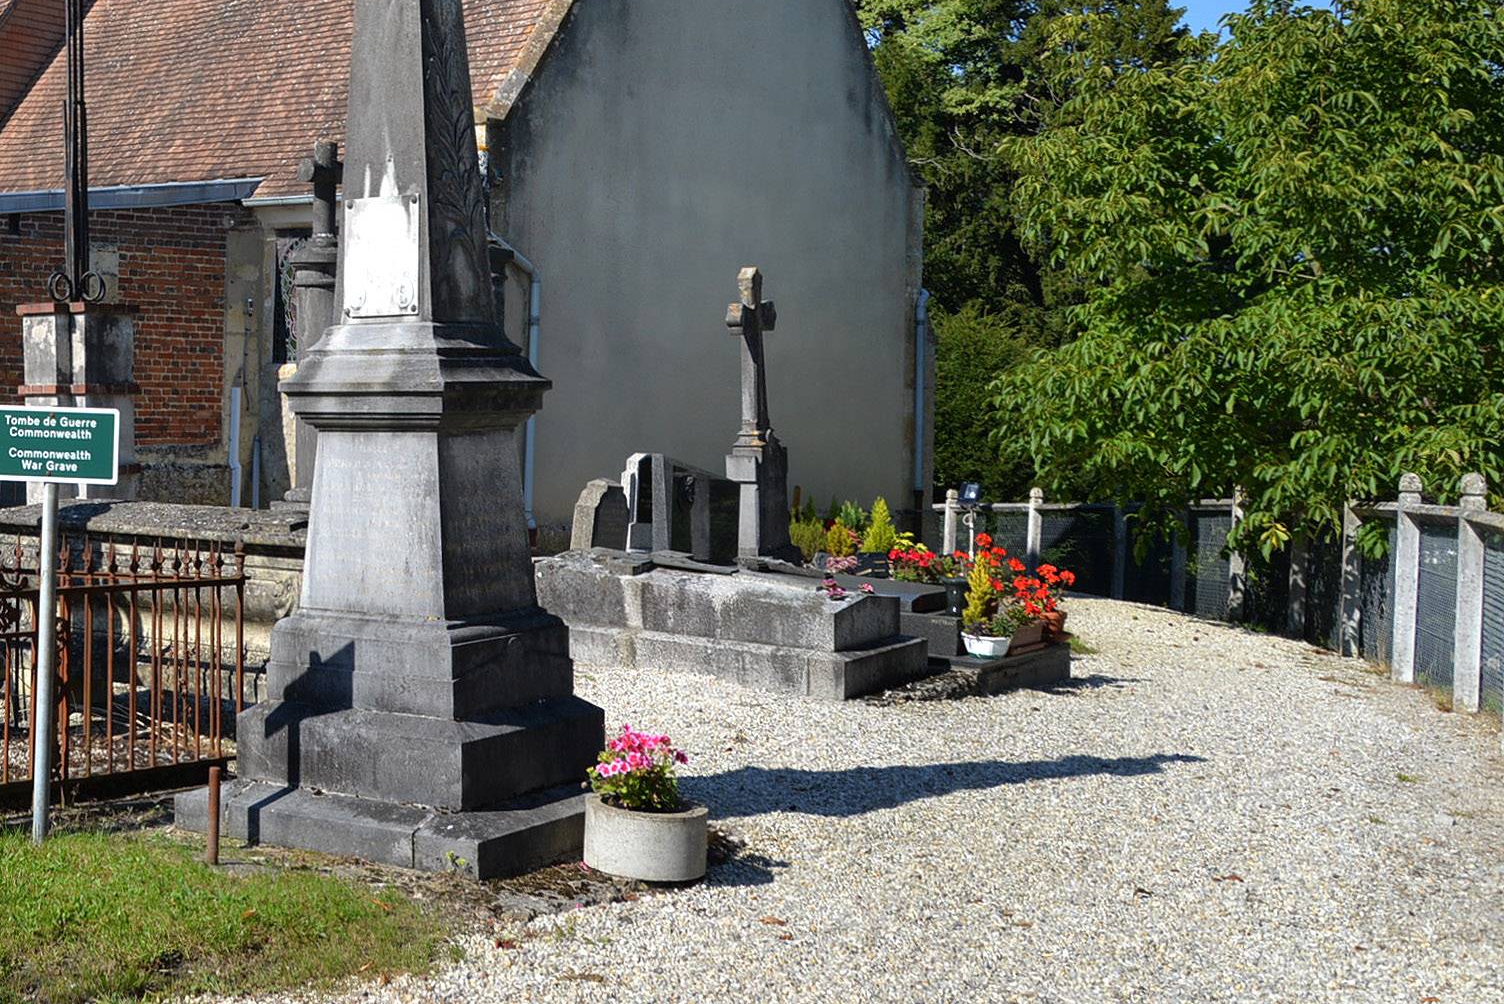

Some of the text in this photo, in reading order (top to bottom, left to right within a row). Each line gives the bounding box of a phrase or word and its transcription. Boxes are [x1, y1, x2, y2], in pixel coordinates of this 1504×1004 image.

[4, 414, 97, 428] Tombe de Guerre
[9, 426, 92, 440] Commonwealth
[8, 447, 91, 461] Commonwealth
[21, 459, 78, 472] War Grave
